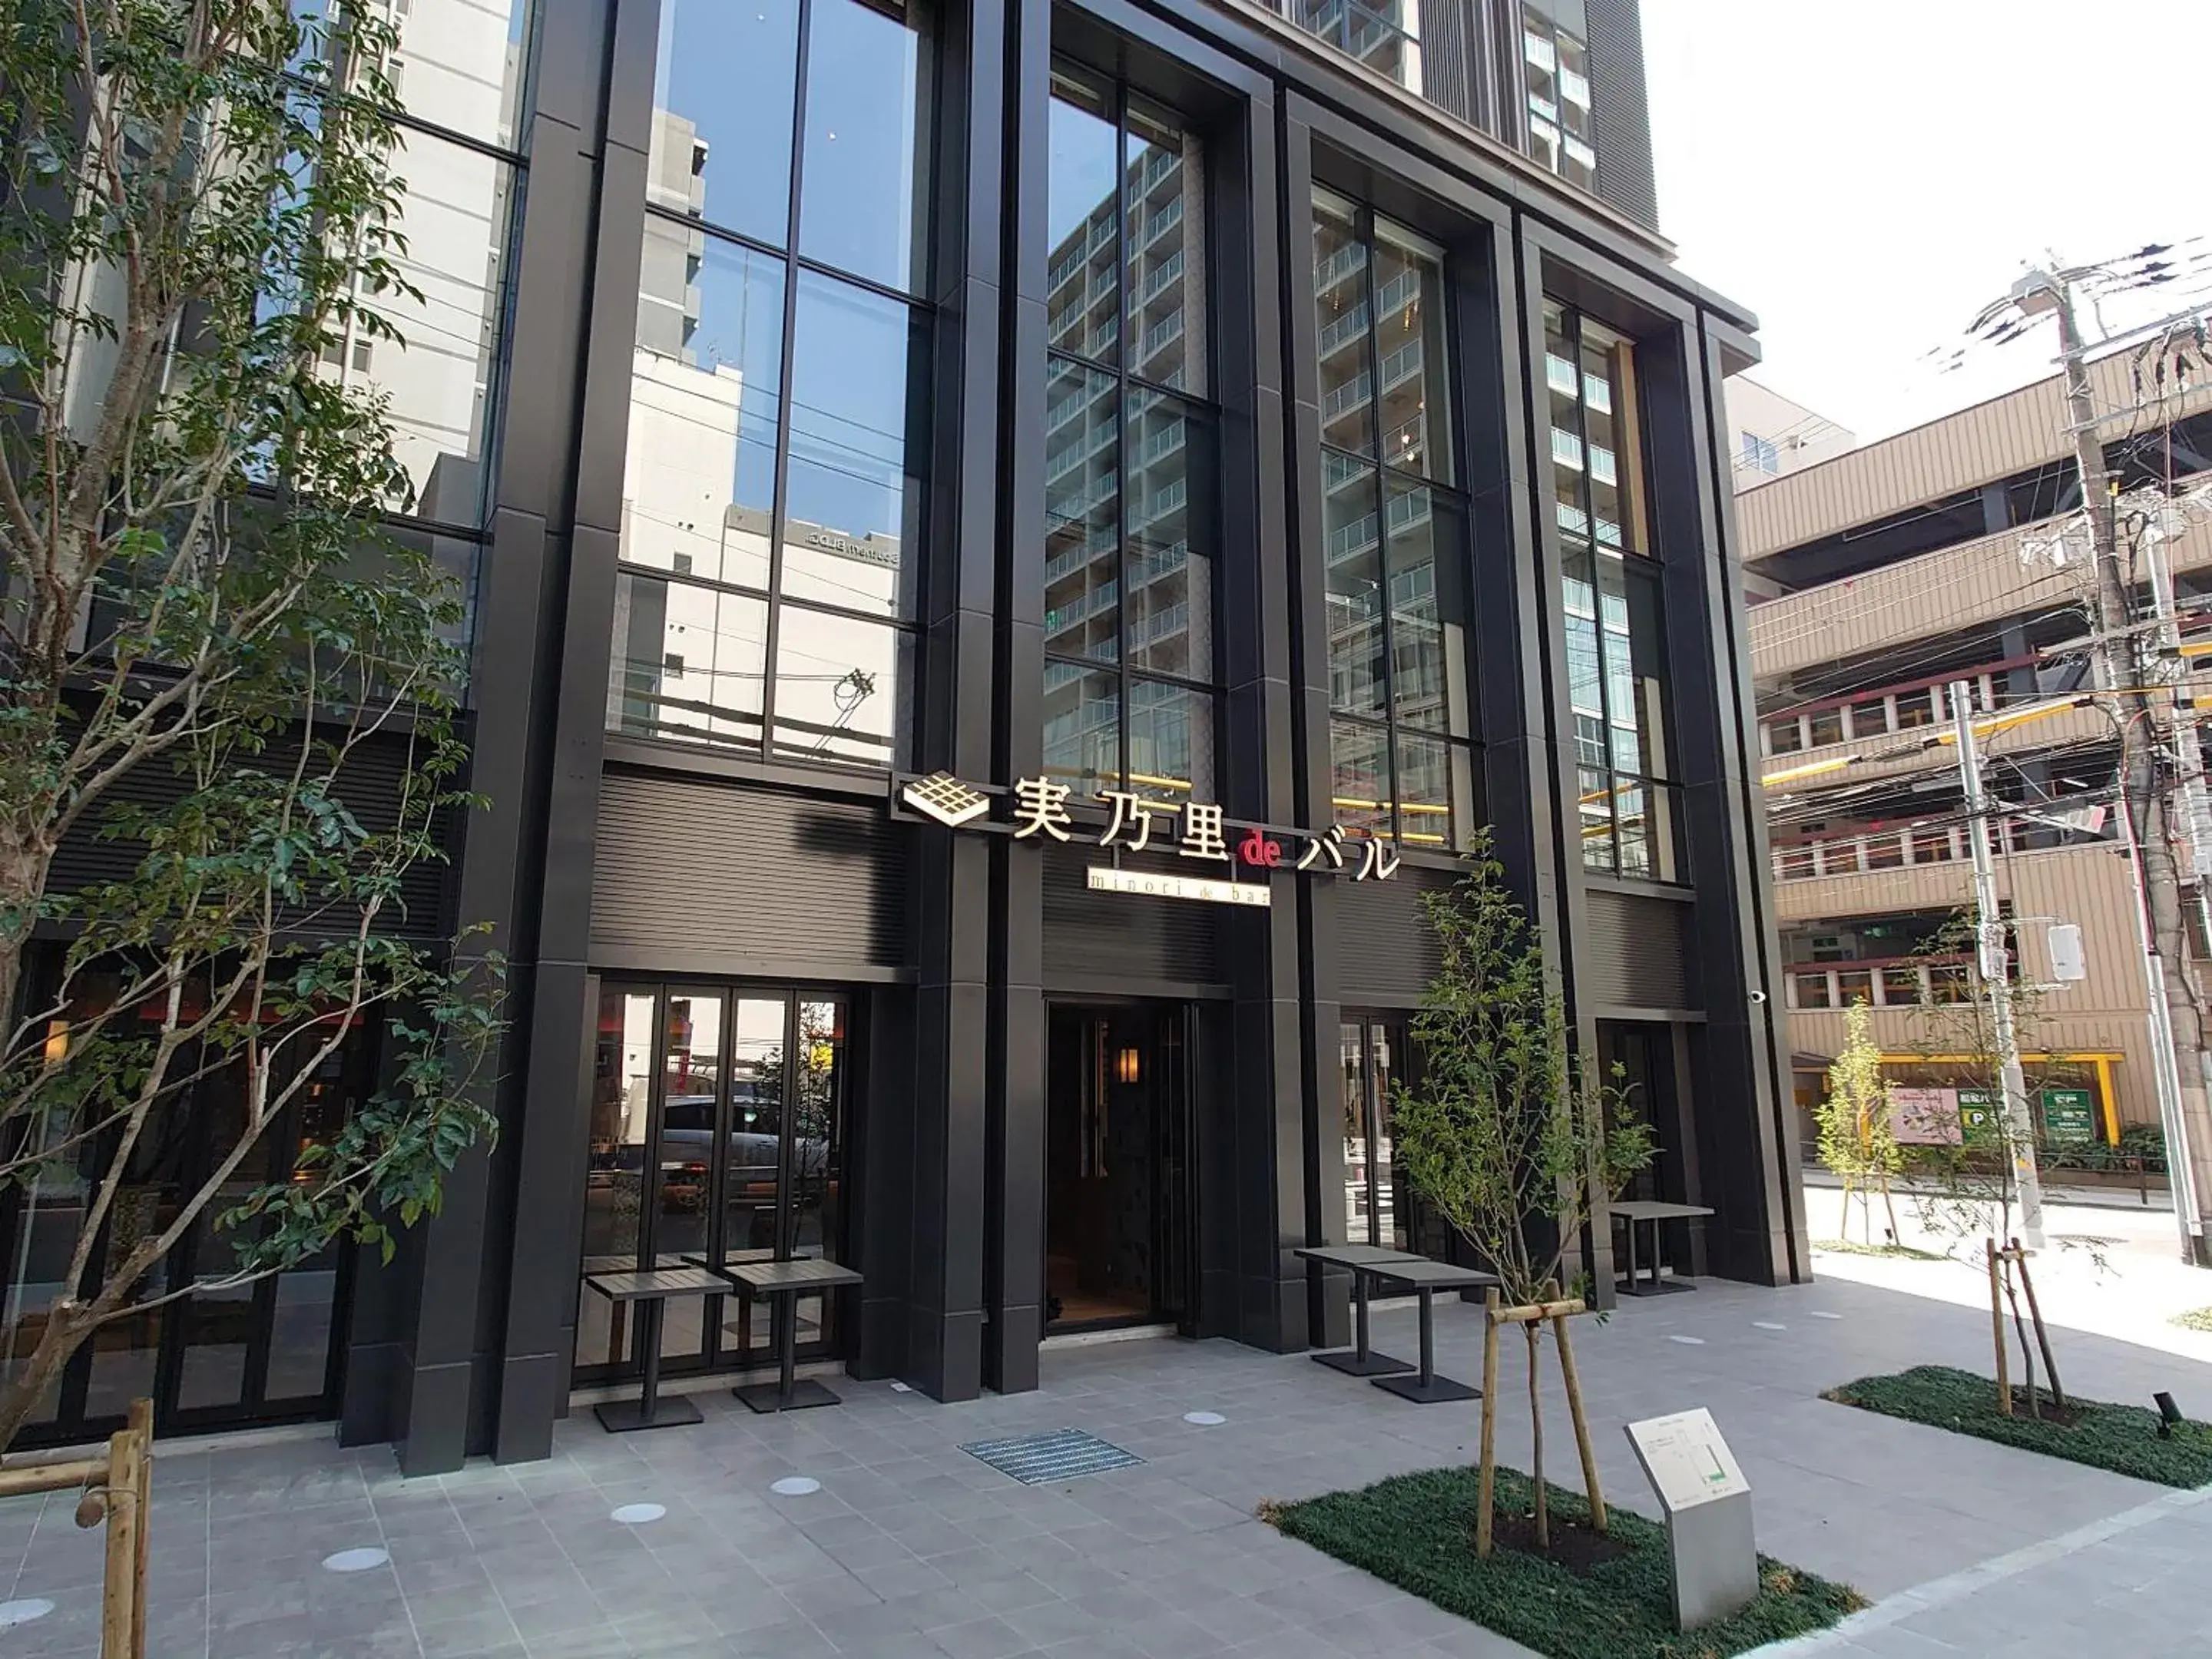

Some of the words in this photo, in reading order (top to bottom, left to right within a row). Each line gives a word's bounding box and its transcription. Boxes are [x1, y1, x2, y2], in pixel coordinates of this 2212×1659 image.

[1090, 872, 1182, 896] minori
[1231, 885, 1270, 905] bar
[1972, 1112, 1985, 1126] P
